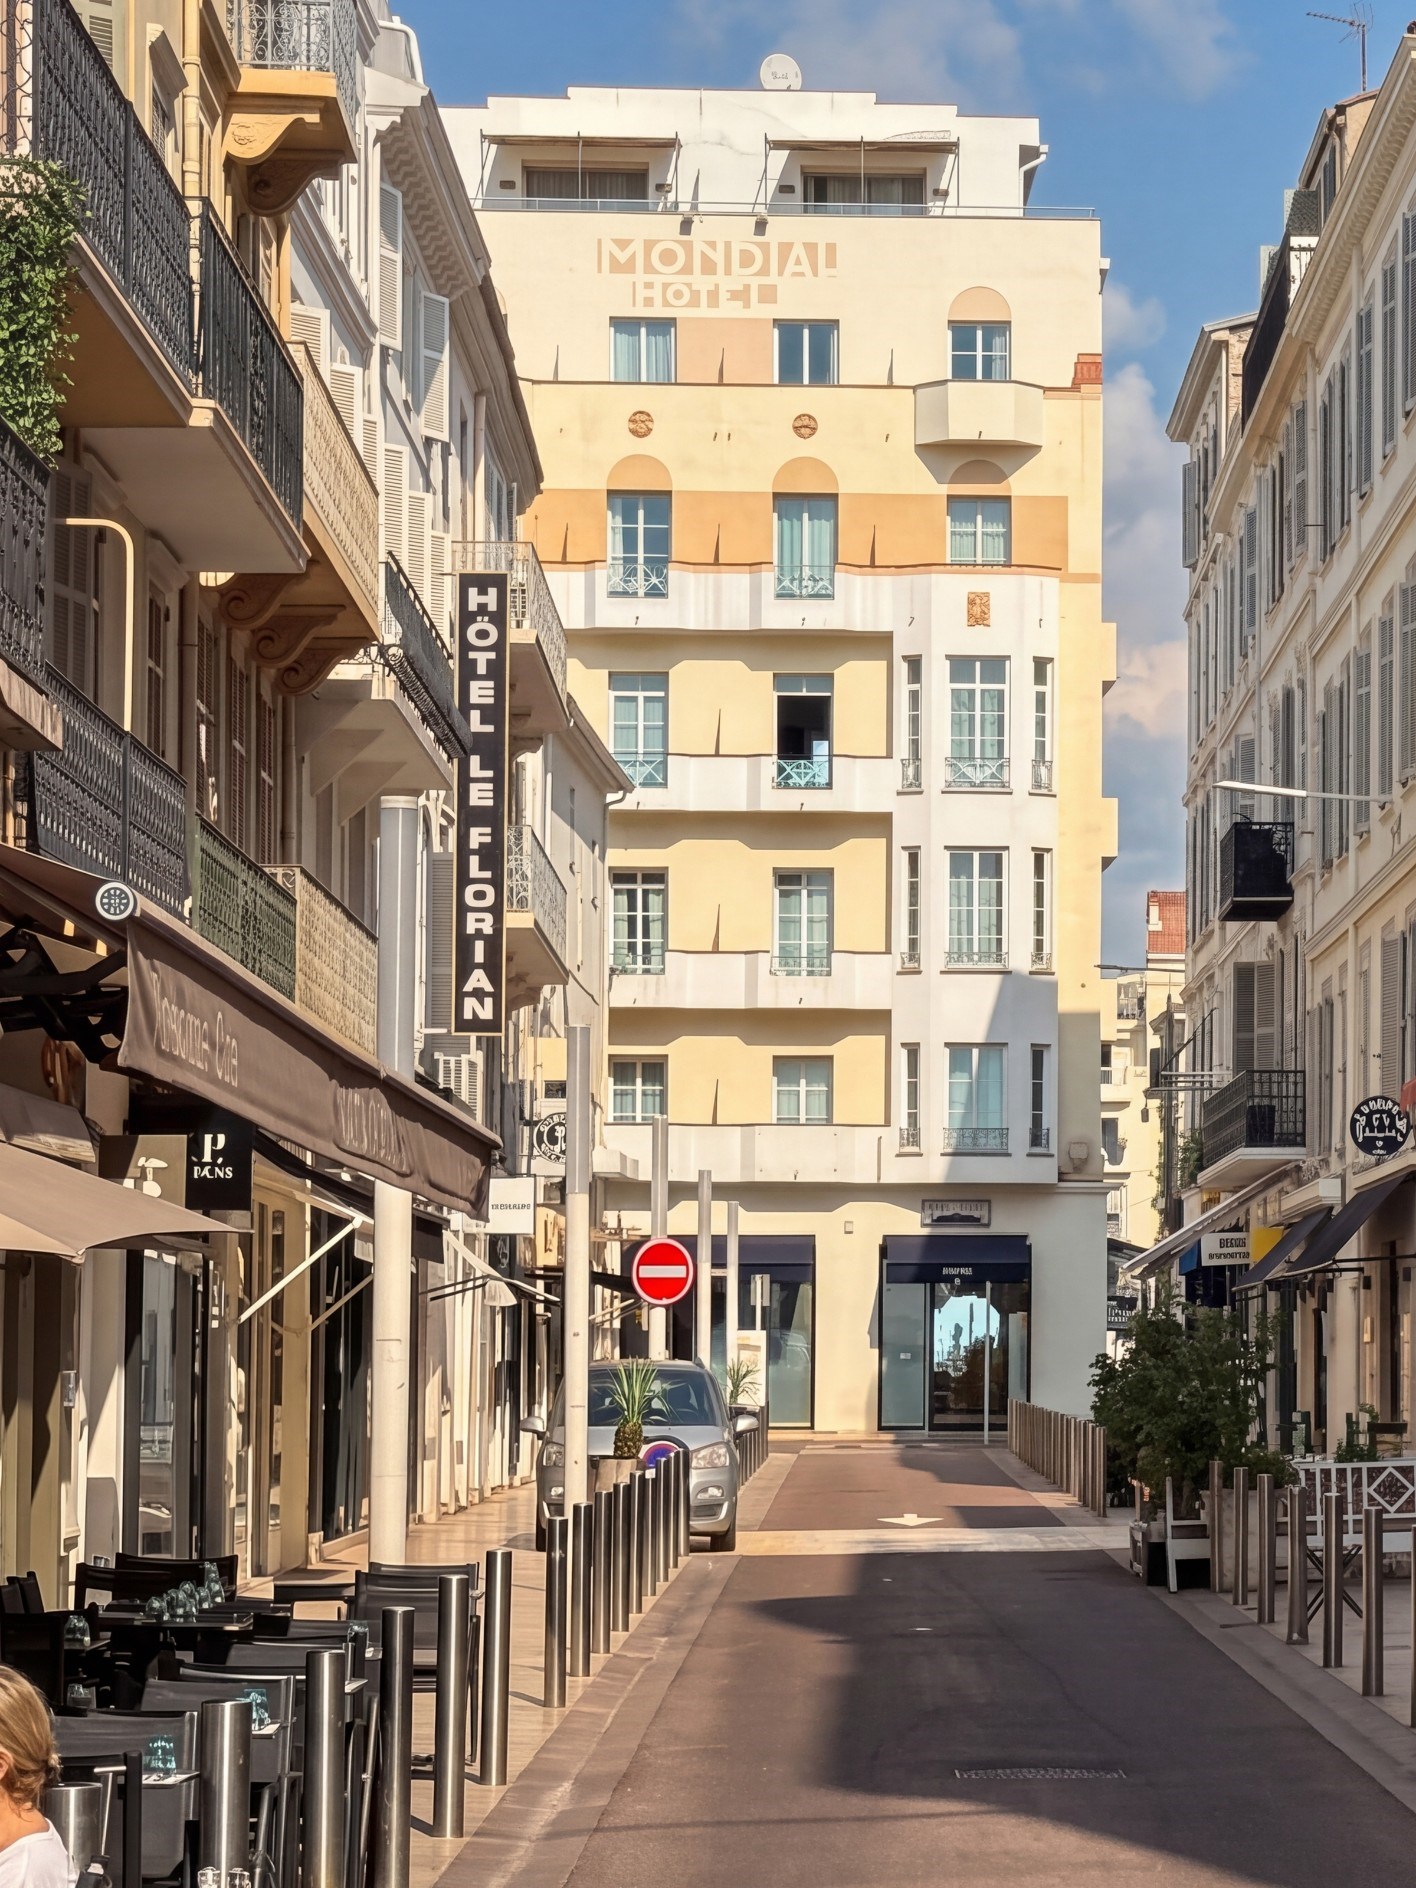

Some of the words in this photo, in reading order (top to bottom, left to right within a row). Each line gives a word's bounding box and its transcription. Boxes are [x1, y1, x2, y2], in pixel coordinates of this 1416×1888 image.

[597, 238, 837, 278] MONDIAL
[632, 281, 778, 309] HOTEL
[469, 755, 494, 806] LE
[462, 827, 496, 1020] FLORIAN
